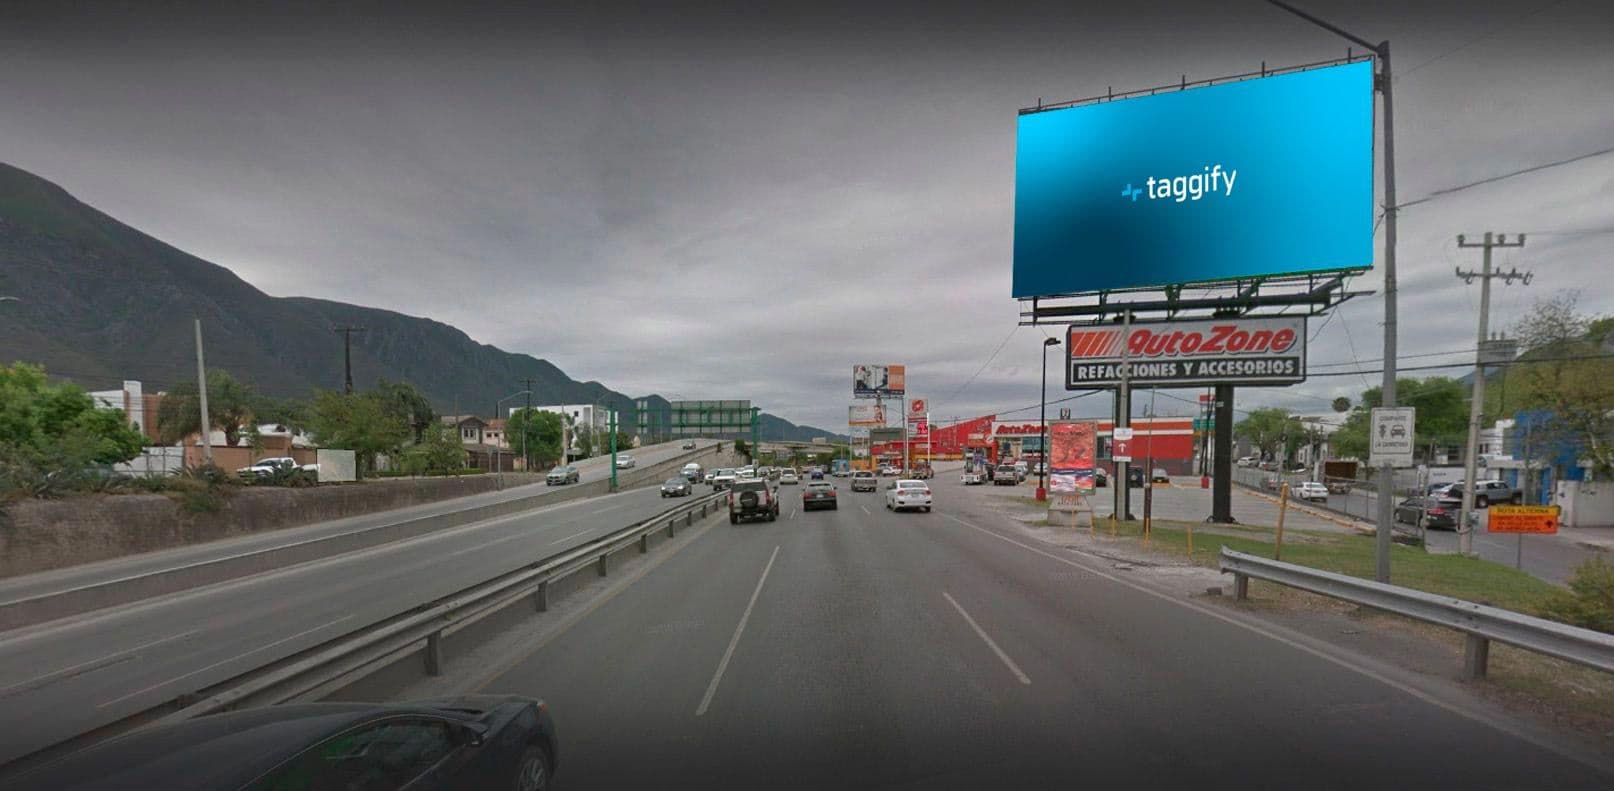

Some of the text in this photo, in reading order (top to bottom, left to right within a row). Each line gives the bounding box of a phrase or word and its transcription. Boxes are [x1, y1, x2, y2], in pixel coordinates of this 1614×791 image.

[1146, 164, 1237, 202] taggify
[1121, 325, 1296, 357] AutoZone
[1077, 360, 1294, 379] REFACCIONES Y ACCESORIOS
